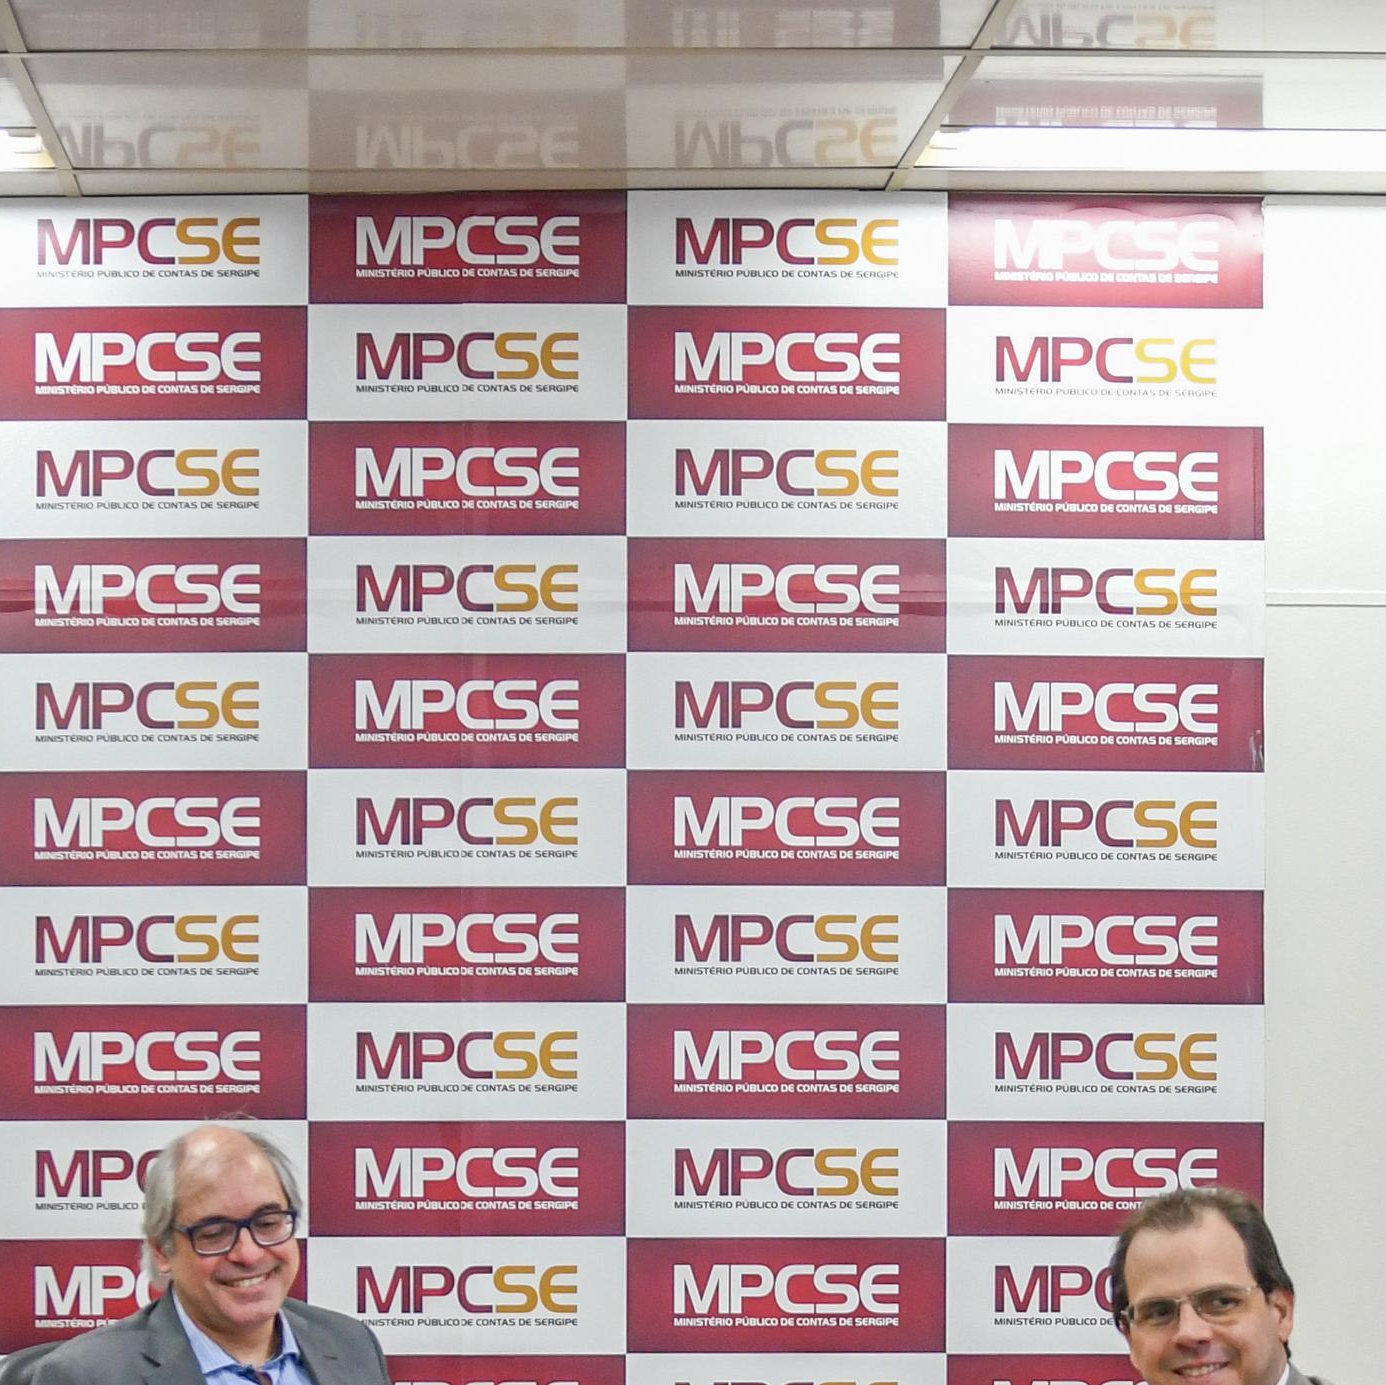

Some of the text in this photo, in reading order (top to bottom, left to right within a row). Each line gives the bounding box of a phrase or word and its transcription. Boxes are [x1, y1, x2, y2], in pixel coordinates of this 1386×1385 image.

[36, 217, 260, 264] MPCSE
[357, 217, 579, 265] MPCSE
[676, 218, 899, 264] MPCSE
[995, 218, 1219, 269] MPCSE
[35, 333, 260, 382] MPCSE
[357, 332, 578, 379] MPCSE
[675, 333, 900, 382] MPCSE
[996, 337, 1215, 383] MPCSE
[141, 384, 155, 395] DE
[157, 384, 198, 395] CONTAS
[200, 384, 214, 395] DE
[216, 384, 260, 395] SERGIPE
[781, 384, 795, 395] DE
[797, 384, 838, 395] CONTAS
[840, 384, 854, 395] DE
[856, 384, 900, 395] SERGIPE
[37, 449, 259, 496] MPCSE
[356, 448, 579, 496] MPCSE
[676, 449, 898, 496] MPCSE
[995, 451, 1218, 500] MPCSE
[461, 500, 475, 509] DE
[477, 500, 518, 509] CONTAS
[520, 500, 533, 509] DE
[535, 500, 579, 509] SERGIPE
[35, 565, 260, 614] MPCSE
[357, 565, 578, 612] MPCSE
[675, 564, 899, 613] MPCSE
[996, 568, 1217, 615] MPCSE
[1100, 620, 1114, 628] DE
[1116, 620, 1157, 628] CONTAS
[1159, 620, 1172, 628] DE
[1174, 620, 1218, 628] SERGIPE
[36, 682, 259, 729] MPCSE
[356, 680, 579, 729] MPCSE
[676, 682, 898, 728] MPCSE
[995, 683, 1217, 732] MPCSE
[141, 734, 155, 742] DE
[157, 734, 198, 742] CONTAS
[200, 734, 214, 742] DE
[216, 734, 260, 742] SERGIPE
[461, 732, 475, 742] DE
[477, 732, 518, 742] CONTAS
[520, 732, 533, 742] DE
[535, 732, 579, 742] SERGIPE
[35, 798, 260, 847] MPCSE
[357, 798, 577, 845] MPCSE
[675, 797, 899, 846] MPCSE
[996, 800, 1217, 847] MPCSE
[36, 916, 258, 963] MPCSE
[356, 914, 578, 963] MPCSE
[675, 915, 898, 962] MPCSE
[995, 915, 1217, 964] MPCSE
[780, 967, 794, 975] DE
[796, 967, 837, 975] CONTAS
[839, 967, 853, 975] DE
[855, 967, 899, 975] SERGIPE
[1100, 967, 1113, 978] DE
[1115, 967, 1156, 978] CONTAS
[1158, 967, 1172, 978] DE
[1174, 967, 1217, 978] SERGIPE
[35, 1032, 260, 1081] MPCSE
[357, 1032, 577, 1079] MPCSE
[674, 1031, 899, 1080] MPCSE
[996, 1033, 1216, 1080] MPCSE
[141, 1084, 155, 1094] DE
[157, 1084, 198, 1094] CONTAS
[200, 1084, 214, 1094] DE
[216, 1084, 260, 1094] SERGIPE
[356, 1148, 578, 1197] MPCSE
[675, 1149, 898, 1196] MPCSE
[995, 1148, 1217, 1197] MPCSE
[357, 1266, 577, 1313] MPCSE
[674, 1265, 899, 1313] MPCSE
[780, 1317, 794, 1327] DE
[796, 1317, 837, 1327] CONTAS
[839, 1317, 853, 1327] DE
[855, 1317, 899, 1327] SERGIPE
